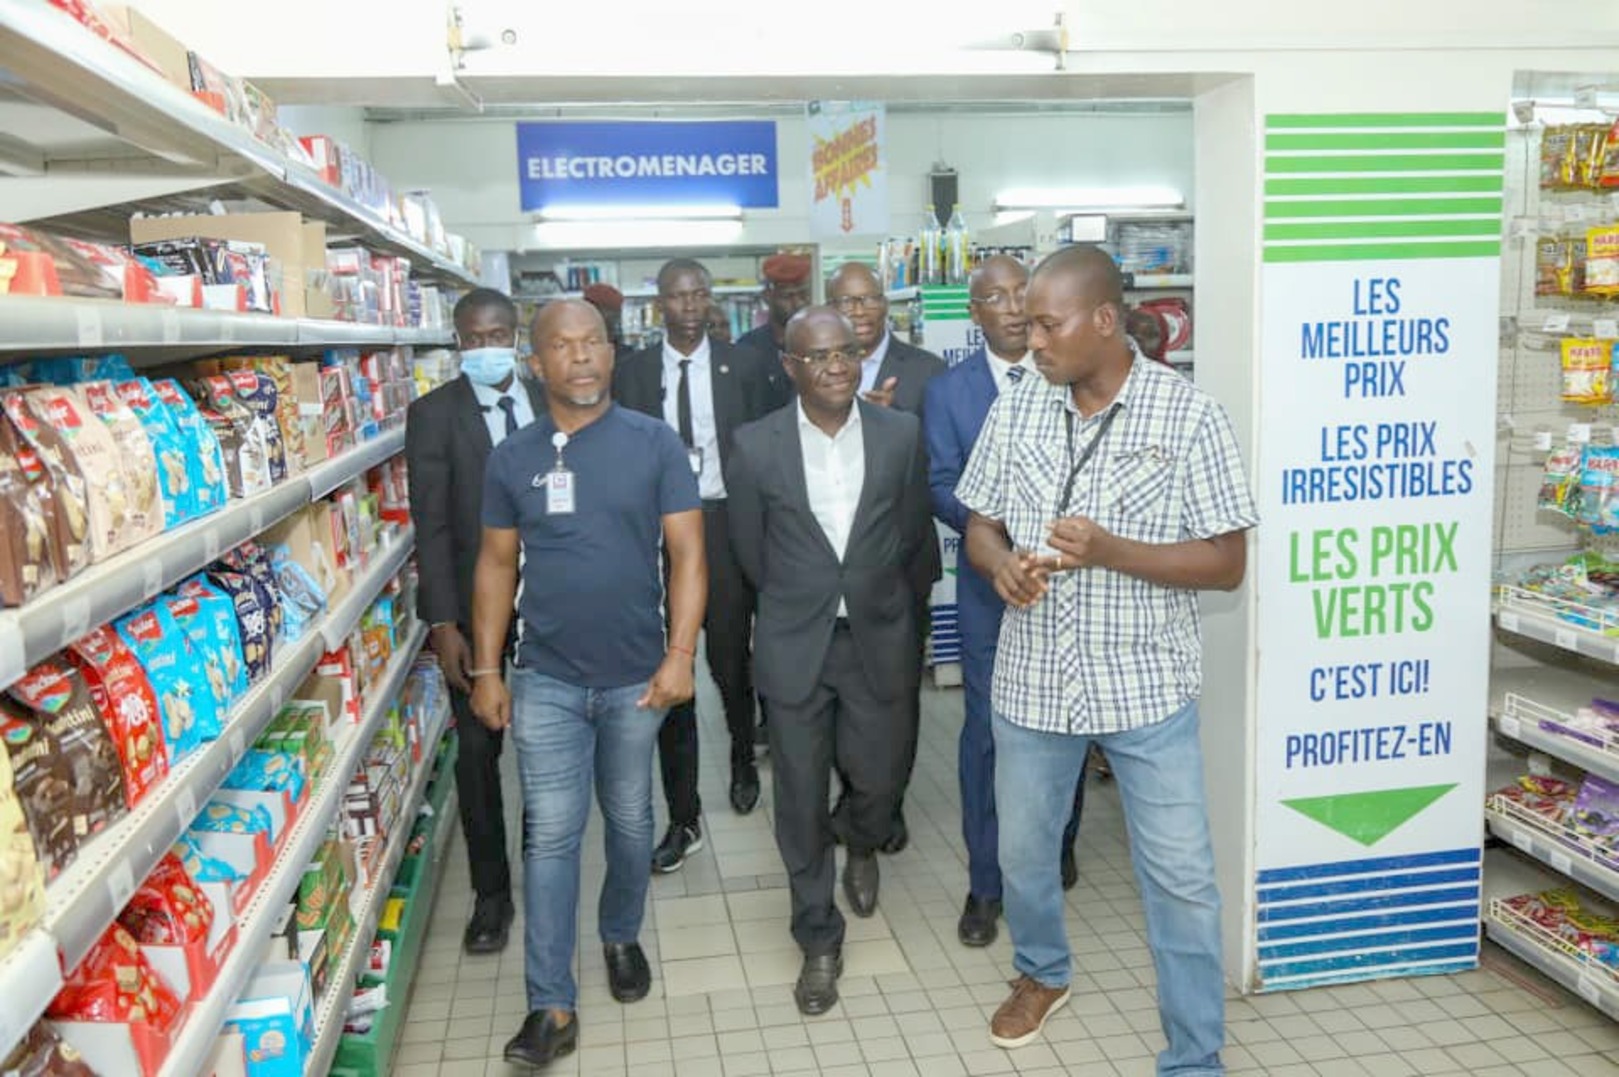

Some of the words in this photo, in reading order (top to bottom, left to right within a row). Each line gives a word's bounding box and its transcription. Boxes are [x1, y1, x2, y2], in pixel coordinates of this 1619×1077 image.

[527, 153, 768, 180] ELECTROMENAGER
[1353, 278, 1401, 315] LES
[1301, 317, 1450, 359] MEILLEURS
[1345, 361, 1406, 399] PRIX
[1321, 425, 1368, 462] LES
[1376, 421, 1437, 459] PRIX
[1282, 459, 1473, 505] IRRESISTIBLES
[1289, 528, 1358, 583] LES
[1371, 521, 1459, 577] PRIX
[1312, 581, 1434, 639] VERTS
[1310, 663, 1382, 702] C'EST
[1390, 659, 1430, 696] ICI!
[1285, 721, 1451, 769] PROFITEZ-EN
